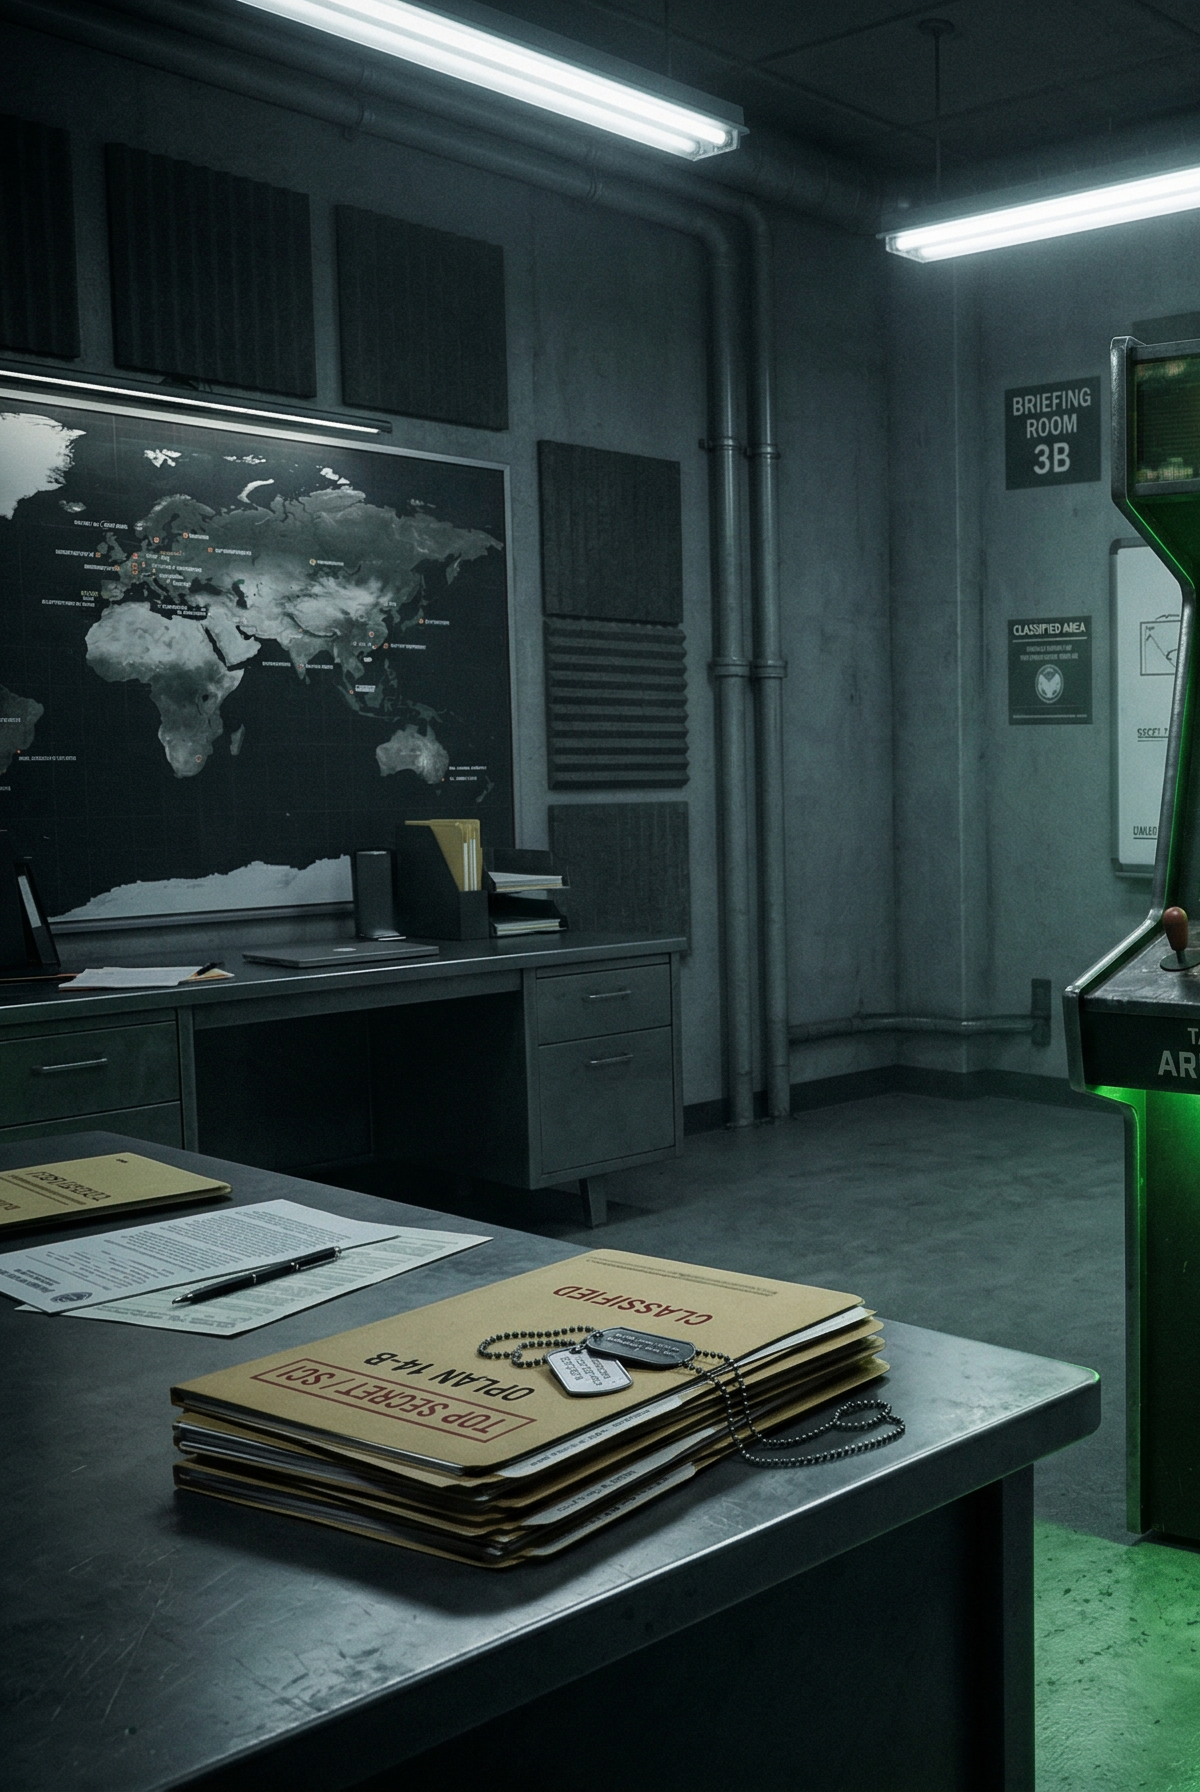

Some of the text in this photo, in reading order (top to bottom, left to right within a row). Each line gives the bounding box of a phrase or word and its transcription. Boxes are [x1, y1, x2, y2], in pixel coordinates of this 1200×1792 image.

[1012, 387, 1091, 416] BRIEFING
[1026, 413, 1077, 439] ROOM
[1033, 442, 1070, 475] 3B
[553, 1285, 713, 1326] CLASSIFIED
[276, 1365, 336, 1386] SCI
[363, 1352, 434, 1376] 14-B
[428, 1368, 535, 1401] OPLAN
[334, 1383, 449, 1417] SECRET
[441, 1411, 506, 1434] TOP
